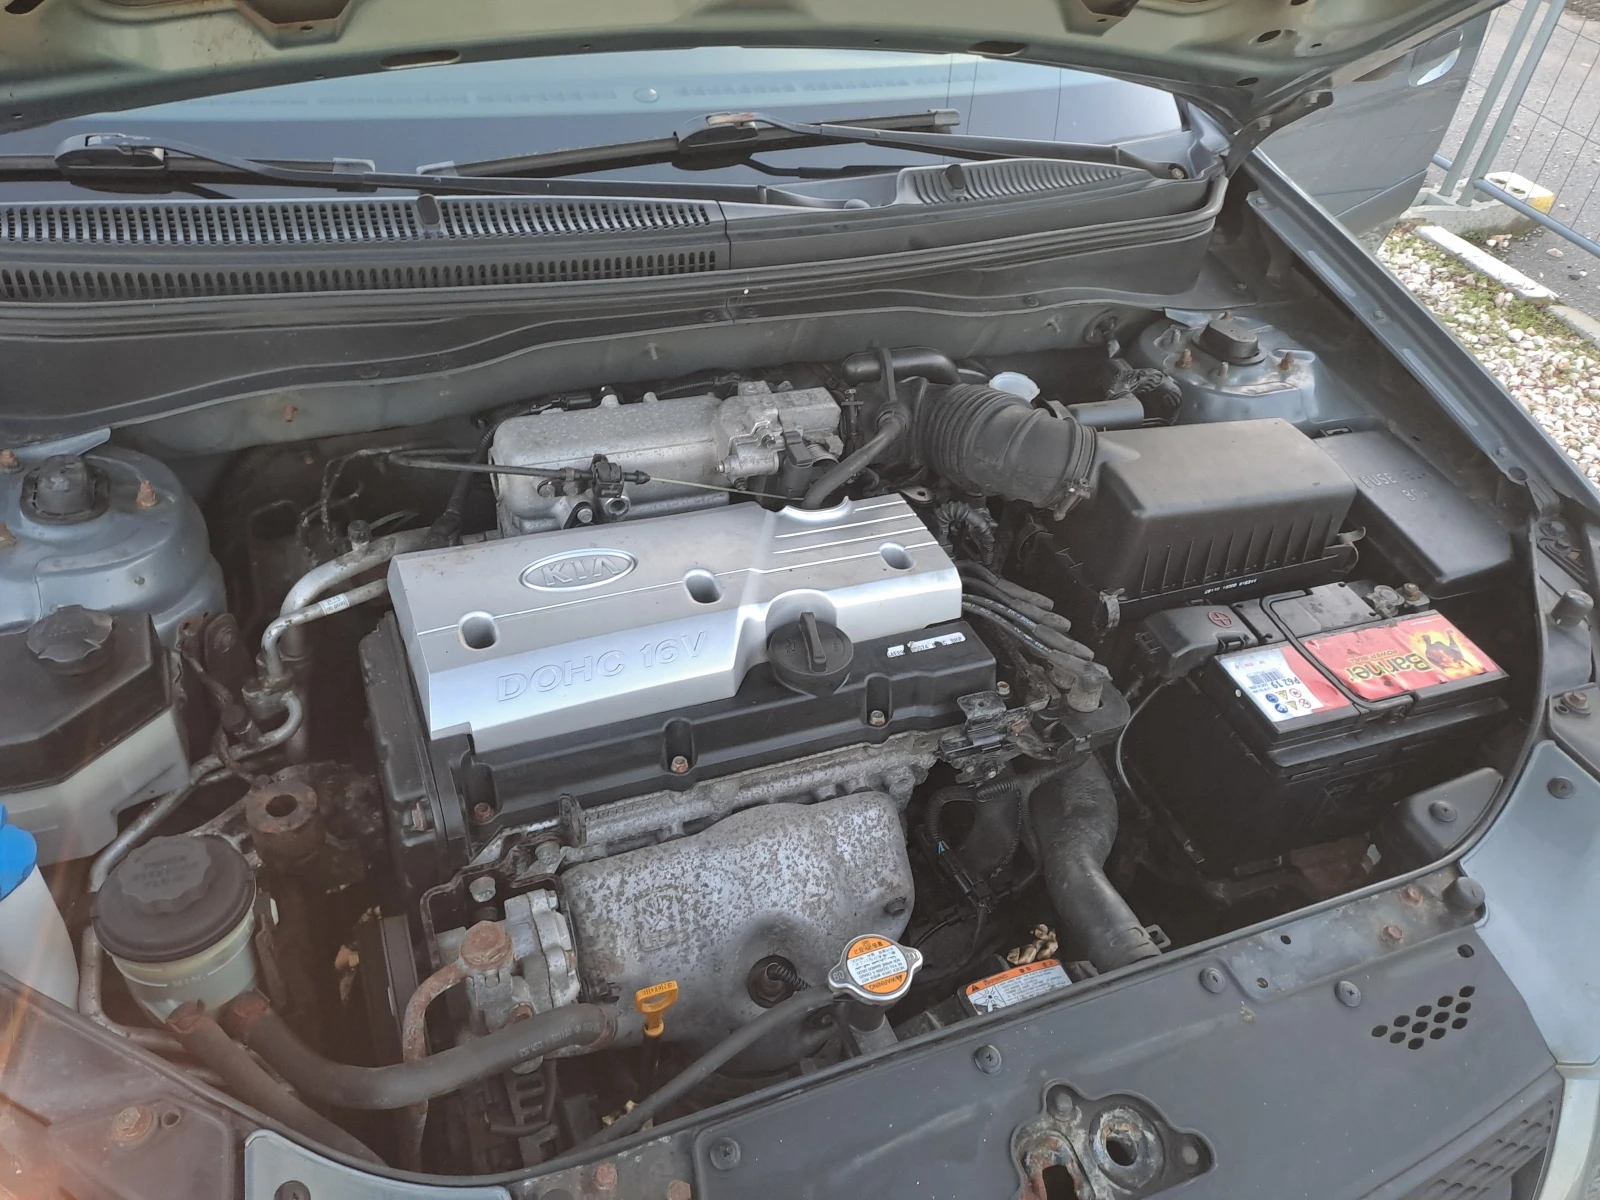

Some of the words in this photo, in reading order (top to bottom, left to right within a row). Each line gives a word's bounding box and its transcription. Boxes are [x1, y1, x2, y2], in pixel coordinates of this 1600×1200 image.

[1359, 472, 1397, 488] FUSE
[539, 557, 620, 586] KIA
[1371, 650, 1398, 658] POWER
[498, 650, 625, 702] DOHC
[640, 631, 706, 668] 16V
[1282, 677, 1301, 687] P62
[869, 977, 896, 990] WARNING
